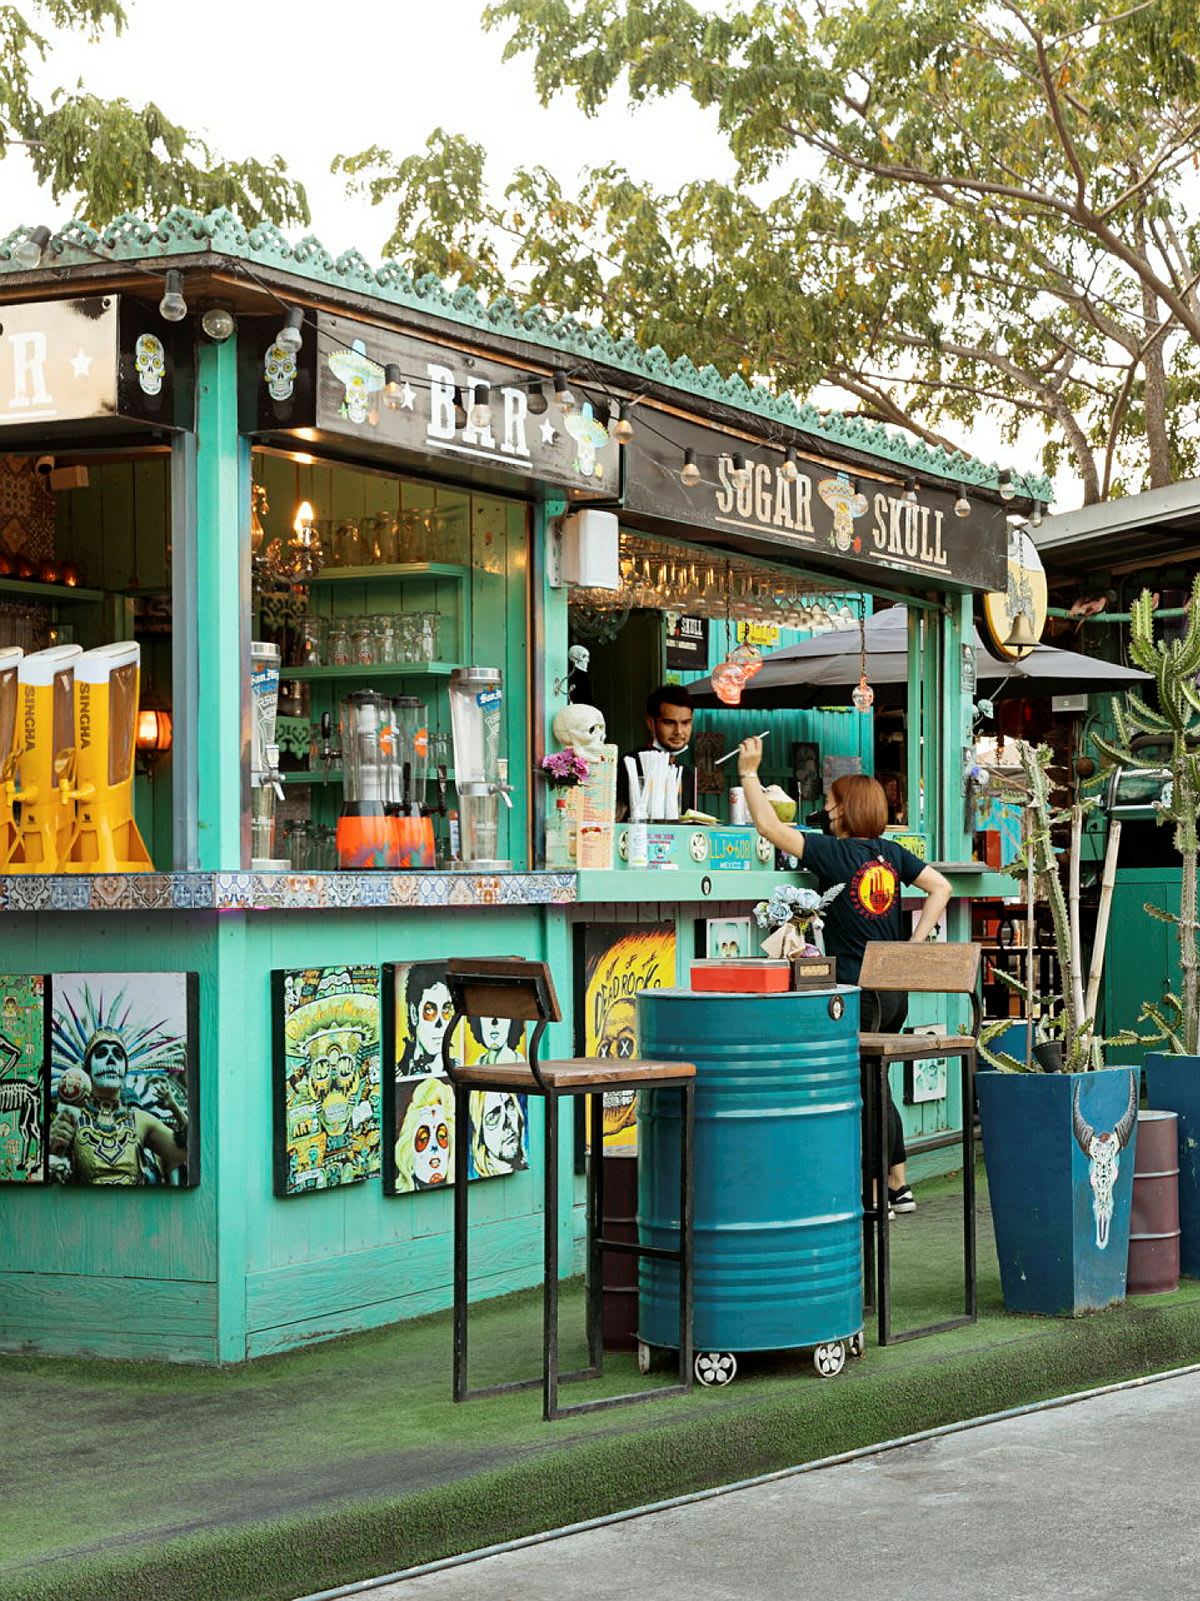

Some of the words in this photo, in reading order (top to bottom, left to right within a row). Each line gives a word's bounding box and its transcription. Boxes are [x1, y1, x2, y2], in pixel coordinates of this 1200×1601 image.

[427, 363, 531, 457] BAR
[716, 453, 815, 533] SUGAR
[872, 493, 948, 565] SKULL
[24, 686, 36, 752] SINGHA
[79, 683, 91, 750] SINGHA
